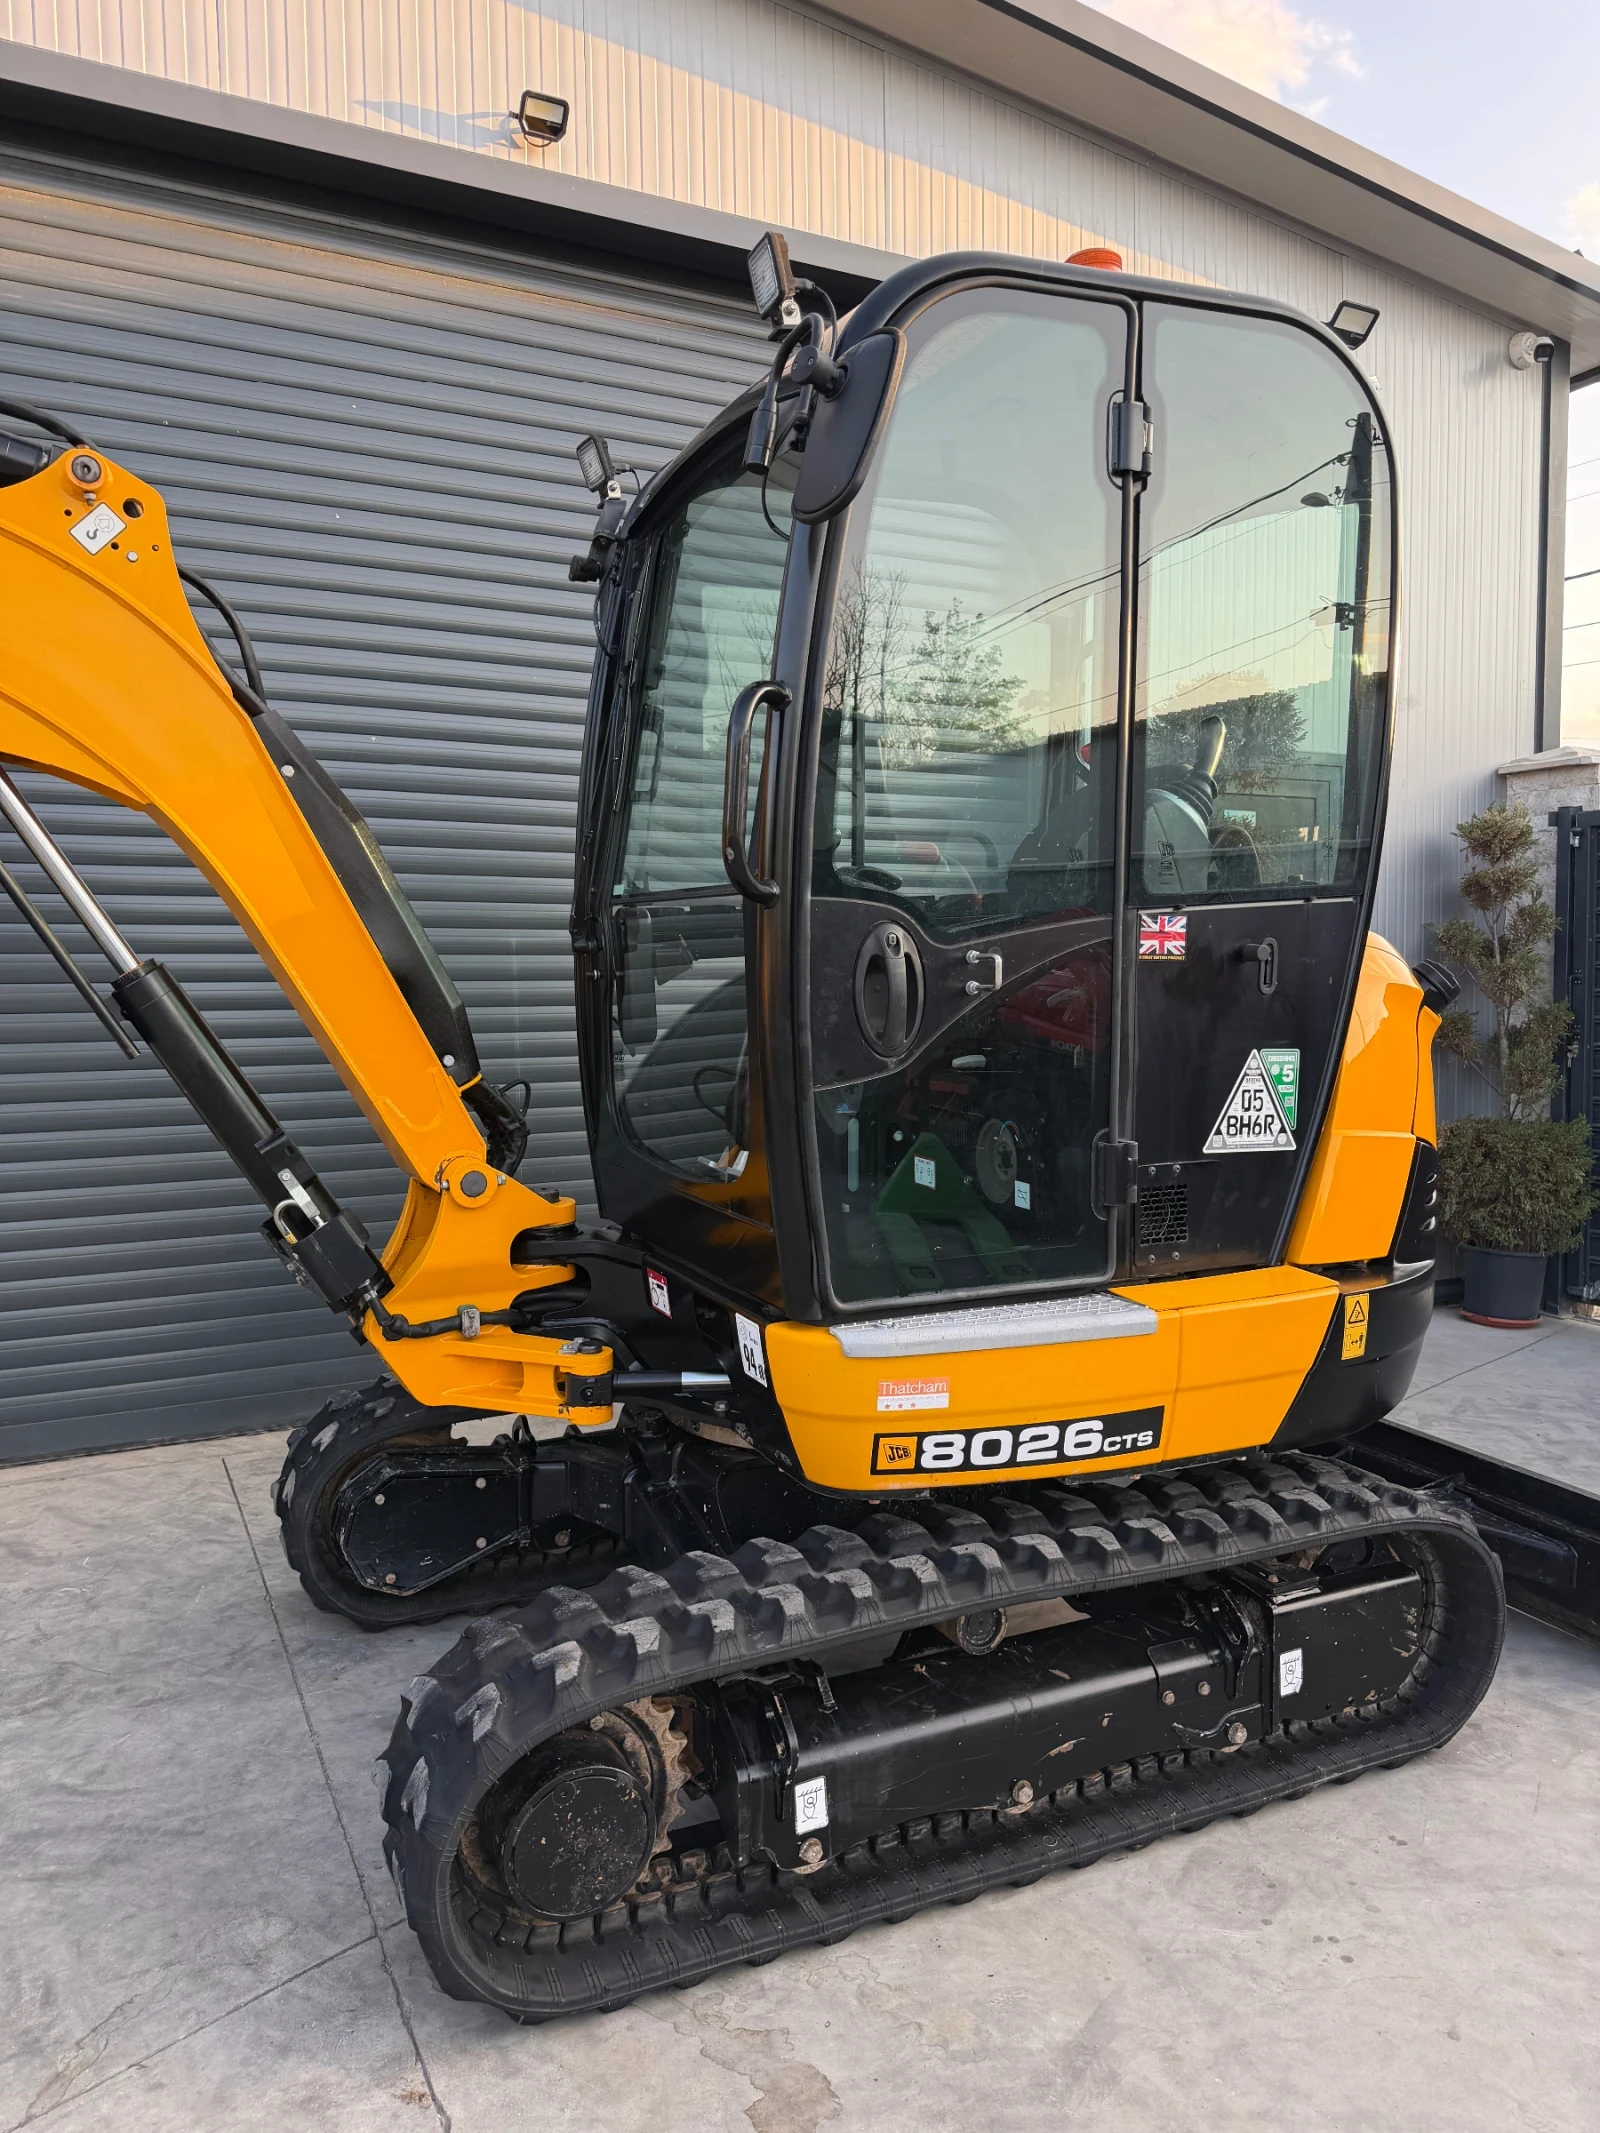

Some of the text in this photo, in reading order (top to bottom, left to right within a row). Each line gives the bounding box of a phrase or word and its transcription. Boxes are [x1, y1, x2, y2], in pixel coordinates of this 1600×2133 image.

[1282, 1064, 1294, 1082] 5
[1241, 1089, 1264, 1112] 05
[1226, 1114, 1274, 1137] BH6R
[743, 1343, 757, 1376] 94
[880, 1381, 947, 1395] Thatcham
[888, 1420, 1153, 1469] JCB 8026 CTS
